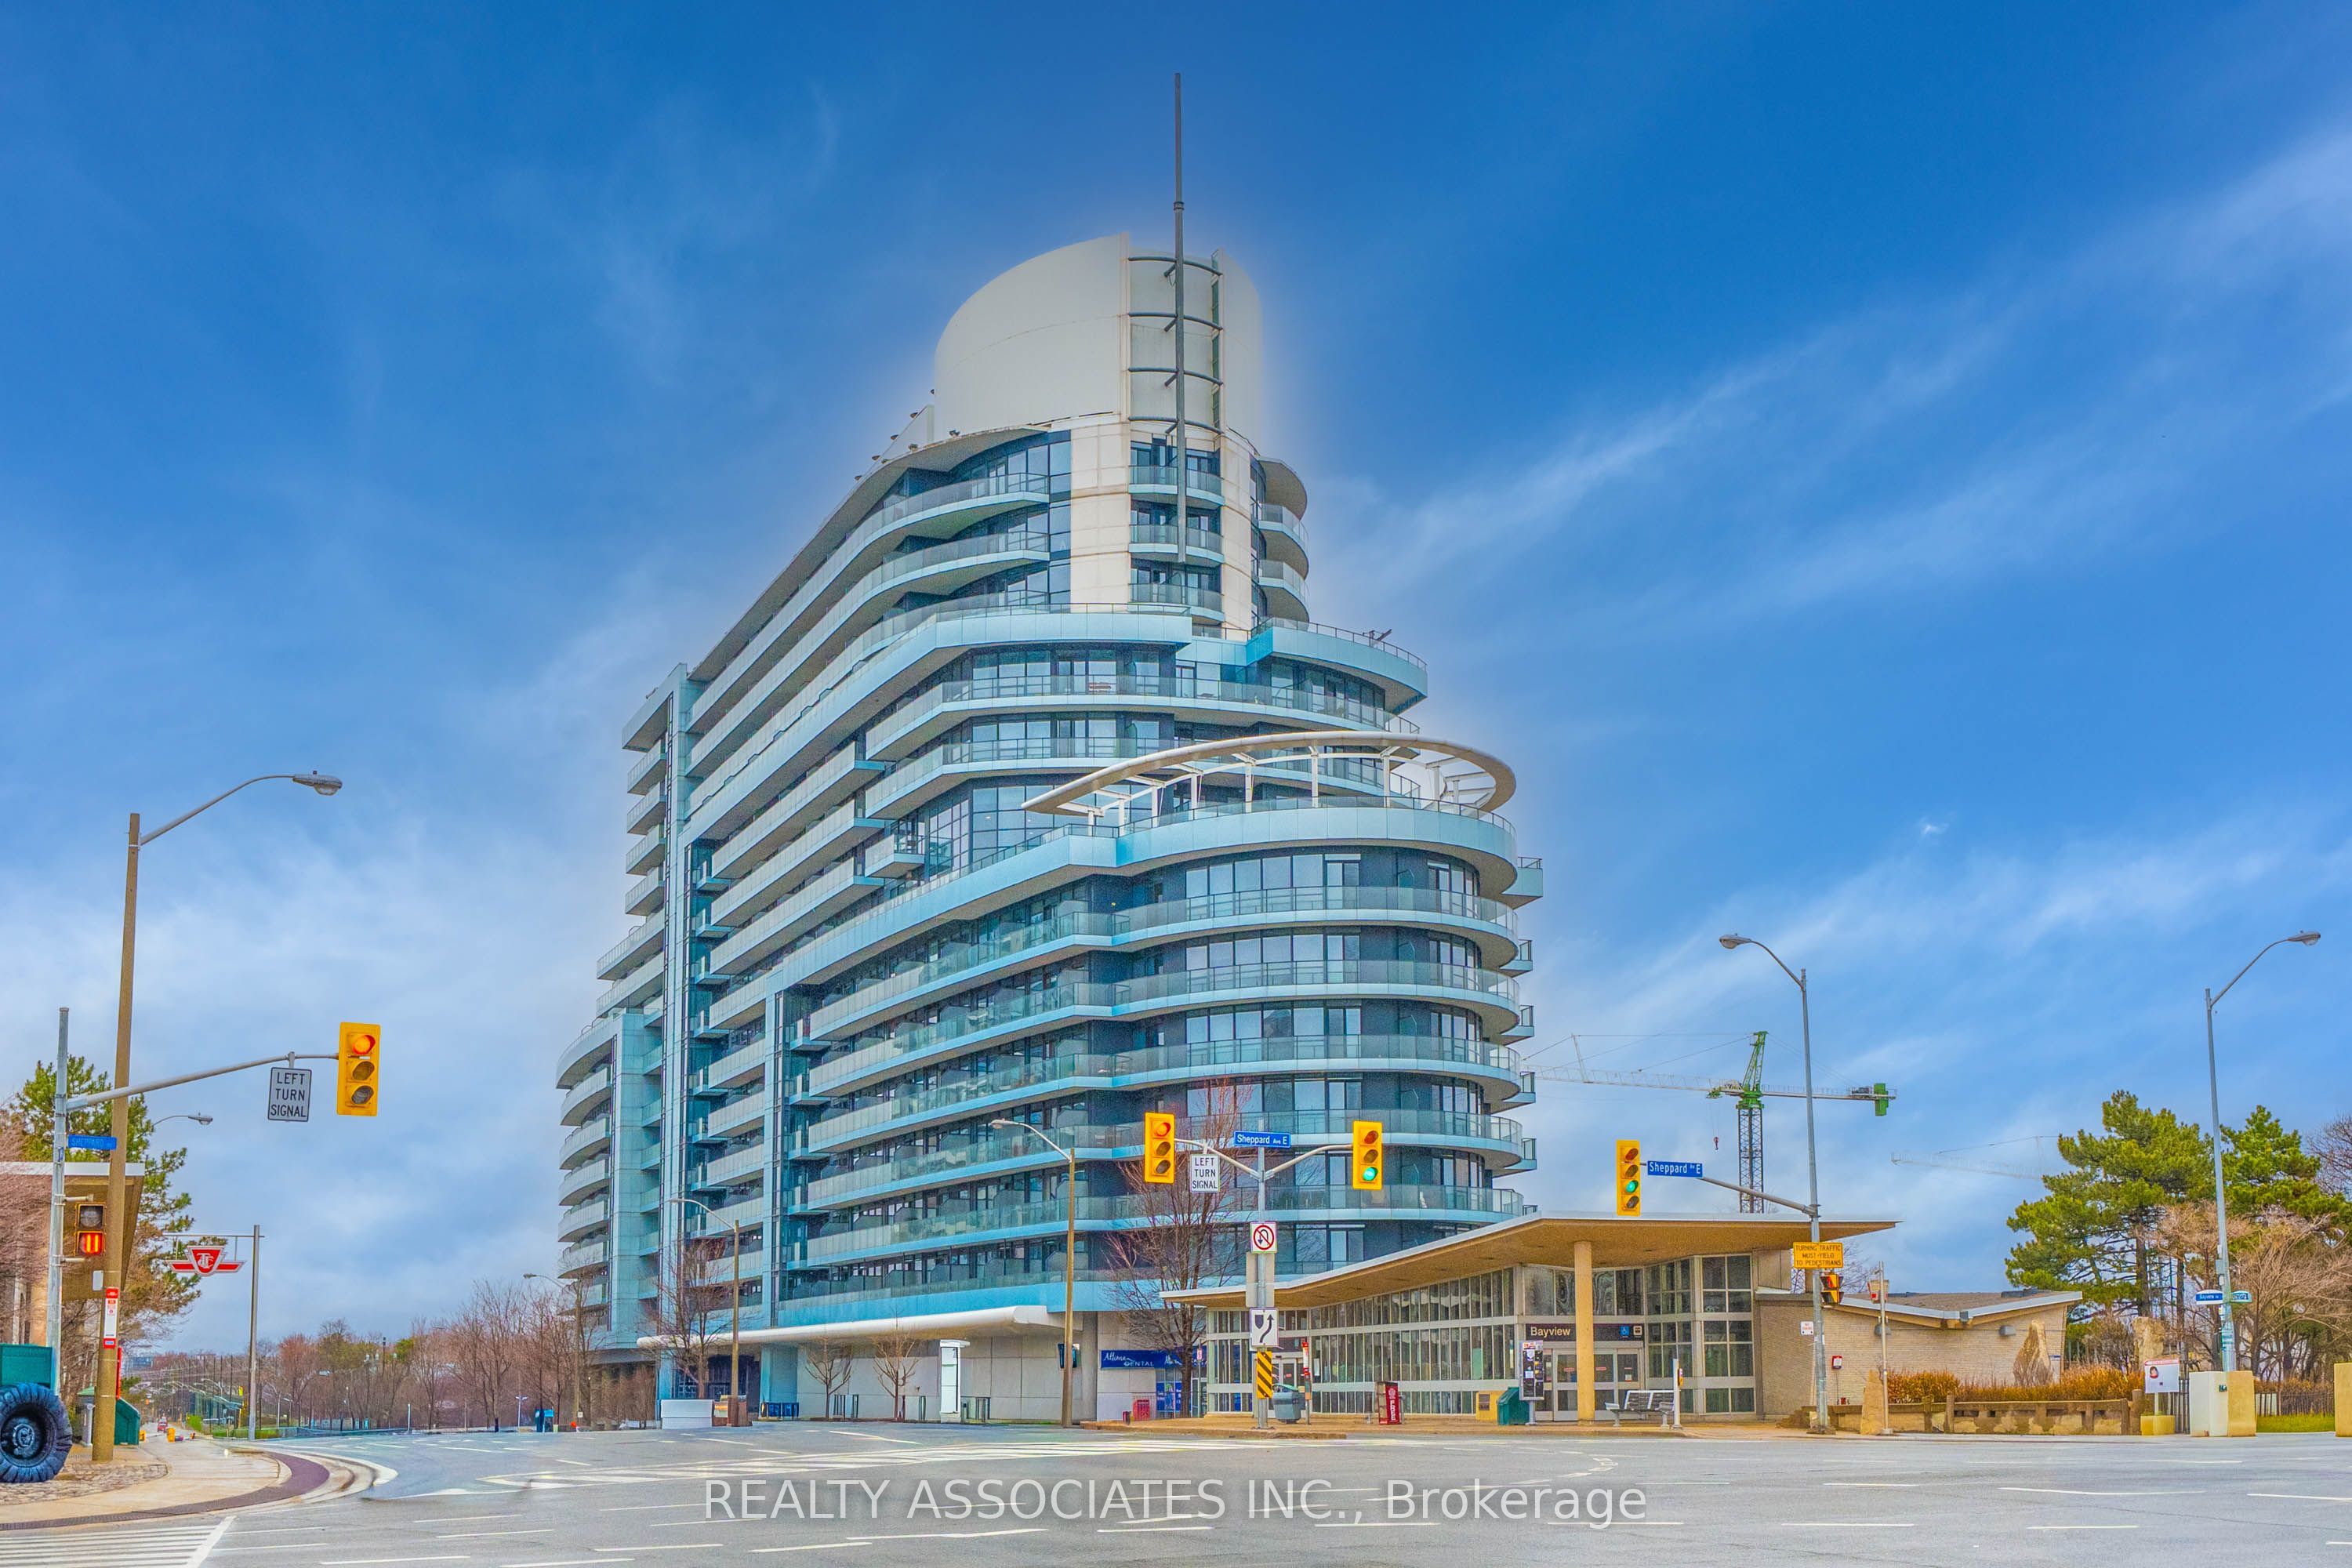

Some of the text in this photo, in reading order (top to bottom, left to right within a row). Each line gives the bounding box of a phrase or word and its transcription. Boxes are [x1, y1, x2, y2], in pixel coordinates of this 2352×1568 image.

[277, 1072, 305, 1085] LEFT
[275, 1088, 305, 1102] TURN
[270, 1104, 307, 1118] SIGNAL
[1237, 1134, 1270, 1145] Sheppard
[1282, 1136, 1287, 1145] E
[1194, 1157, 1214, 1167] LEFT
[1194, 1168, 1216, 1178] TURN
[1650, 1162, 1687, 1174] Sheppard
[1696, 1163, 1700, 1174] E
[1192, 1180, 1218, 1189] SIGNAL
[1530, 1327, 1570, 1338] Bayview
